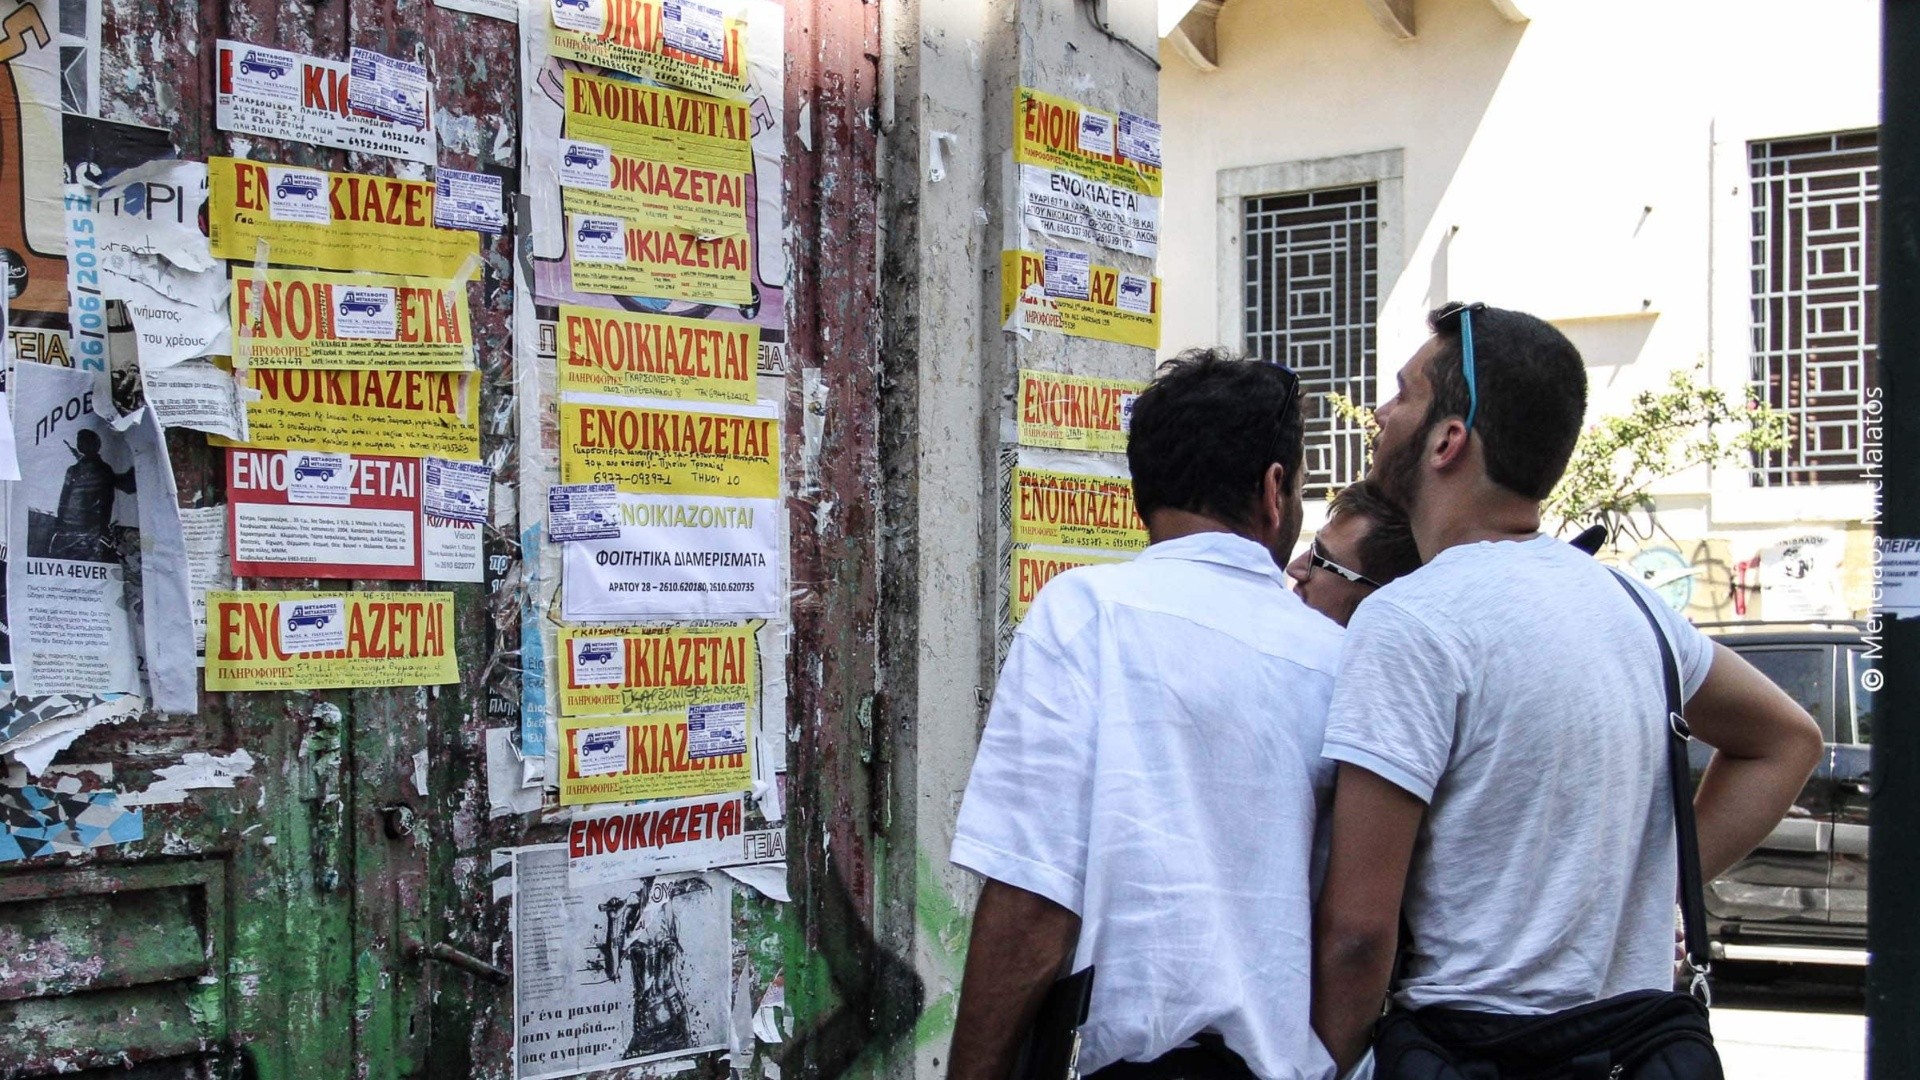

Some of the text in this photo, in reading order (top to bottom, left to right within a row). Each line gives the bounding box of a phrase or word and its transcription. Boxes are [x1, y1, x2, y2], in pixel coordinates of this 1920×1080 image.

[571, 76, 747, 141] ΕΝΟΙΚΙΑΖΕΤΑΙ
[1141, 220, 1154, 230] ΚΑΙ
[625, 228, 747, 271] ΙΚΙΑΖΕΤΑΙ
[72, 217, 105, 373] 26/06/2015
[567, 316, 749, 381] ΕΝΟΙΚΙΑΖΕΤΑΙ
[568, 372, 623, 386] ΠΛΗΡΟΦΟΡΙΕΣ
[580, 408, 770, 457] ΕΝΟΙΚΙΑΖΕΤΑΙ
[233, 451, 415, 498] ΕΝΟΖΕΤΑΙ
[593, 471, 672, 485] 6977-093971
[727, 475, 740, 485] 10
[618, 502, 754, 529] ΝΟΙΚΙΑΖΟΝΤΑΙ
[454, 531, 476, 540] Vision
[1020, 525, 1058, 537] ΠΛΗΡΟΦΟΡΙΕΣ
[595, 549, 766, 567] ΦΟΙΤΗΤΙΚΑ ΔΙΑΜΕΡΙΣΜΑΤΑ
[26, 561, 107, 580] LILYA 4EVER
[608, 582, 640, 592] ΑΡΑΤΟΥ
[640, 582, 651, 592] 28
[218, 667, 294, 680] ΠΛΗΡΟΦΟΡΙΕΣ
[568, 694, 621, 706] ΠΛΗΡΟΦΟΡΙΕΣ
[566, 783, 620, 796] ΠΛΗΡΟΦΟΡΙΕΣ
[570, 798, 741, 859] ΕΝΟΙΚΙΑΖΕΤΑΙ
[539, 1009, 562, 1022] ένα
[568, 1000, 622, 1020] μαχαίρι
[522, 1020, 616, 1045] στην καρδιά...
[522, 1051, 546, 1064] σας
